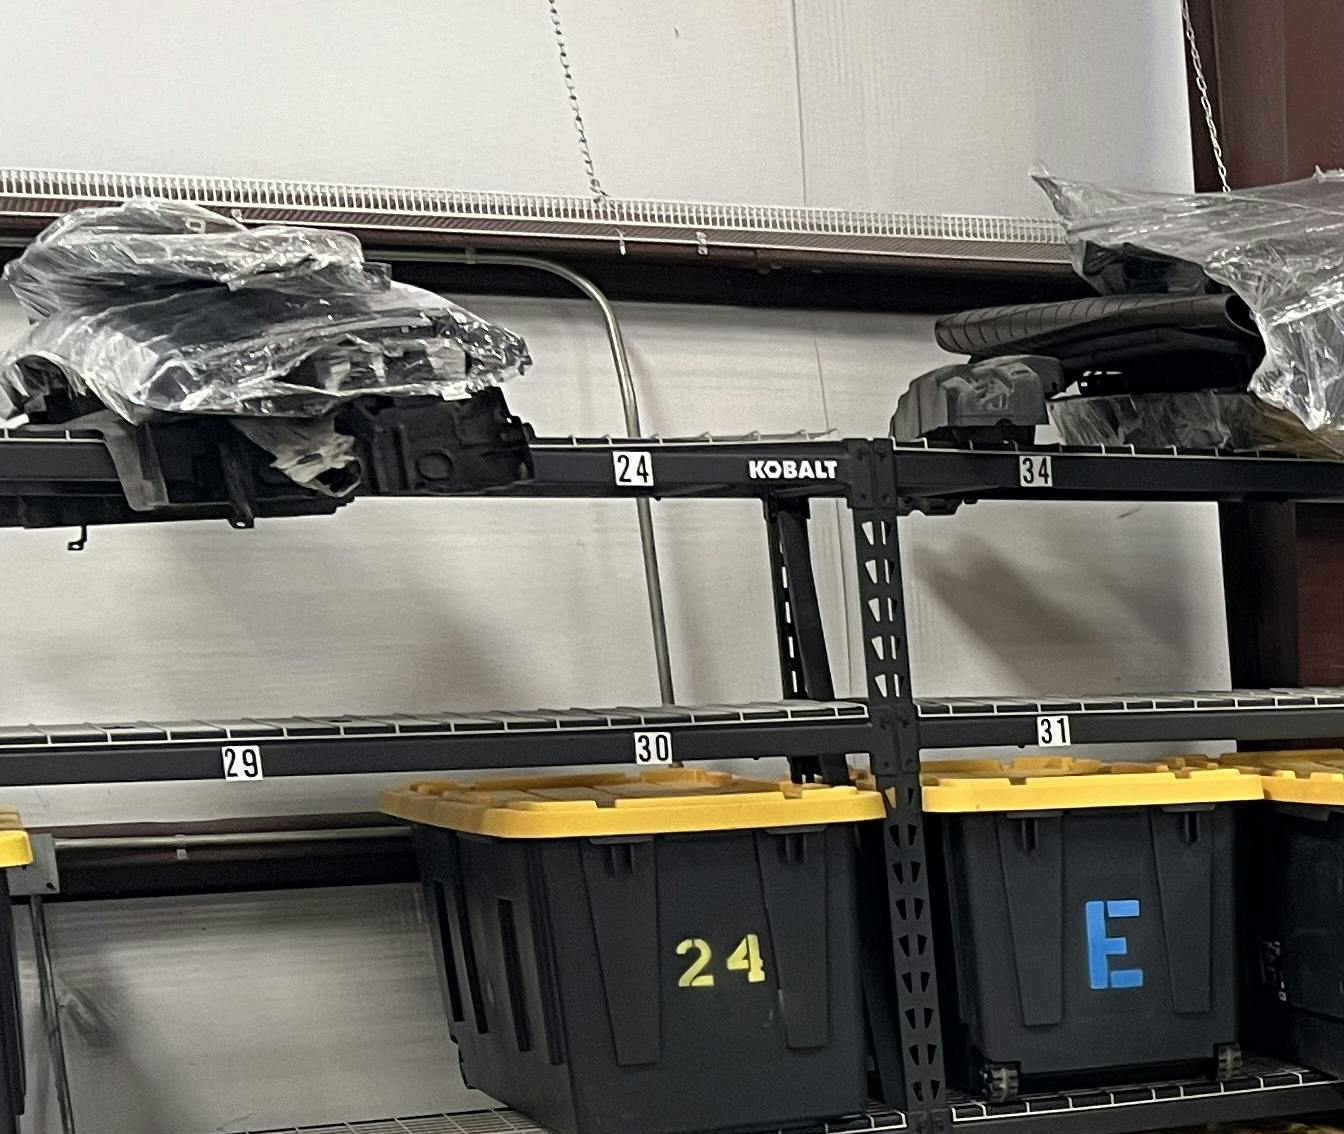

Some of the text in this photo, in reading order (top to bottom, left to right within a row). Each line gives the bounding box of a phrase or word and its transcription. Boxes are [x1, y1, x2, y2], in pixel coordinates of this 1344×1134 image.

[617, 454, 649, 483] 24
[748, 460, 838, 479] KOBALT
[1022, 457, 1050, 484] 34
[1040, 717, 1067, 744] 31
[224, 748, 259, 777] 29
[637, 735, 669, 762] 30
[1085, 899, 1143, 989] E
[675, 933, 766, 988] 24
